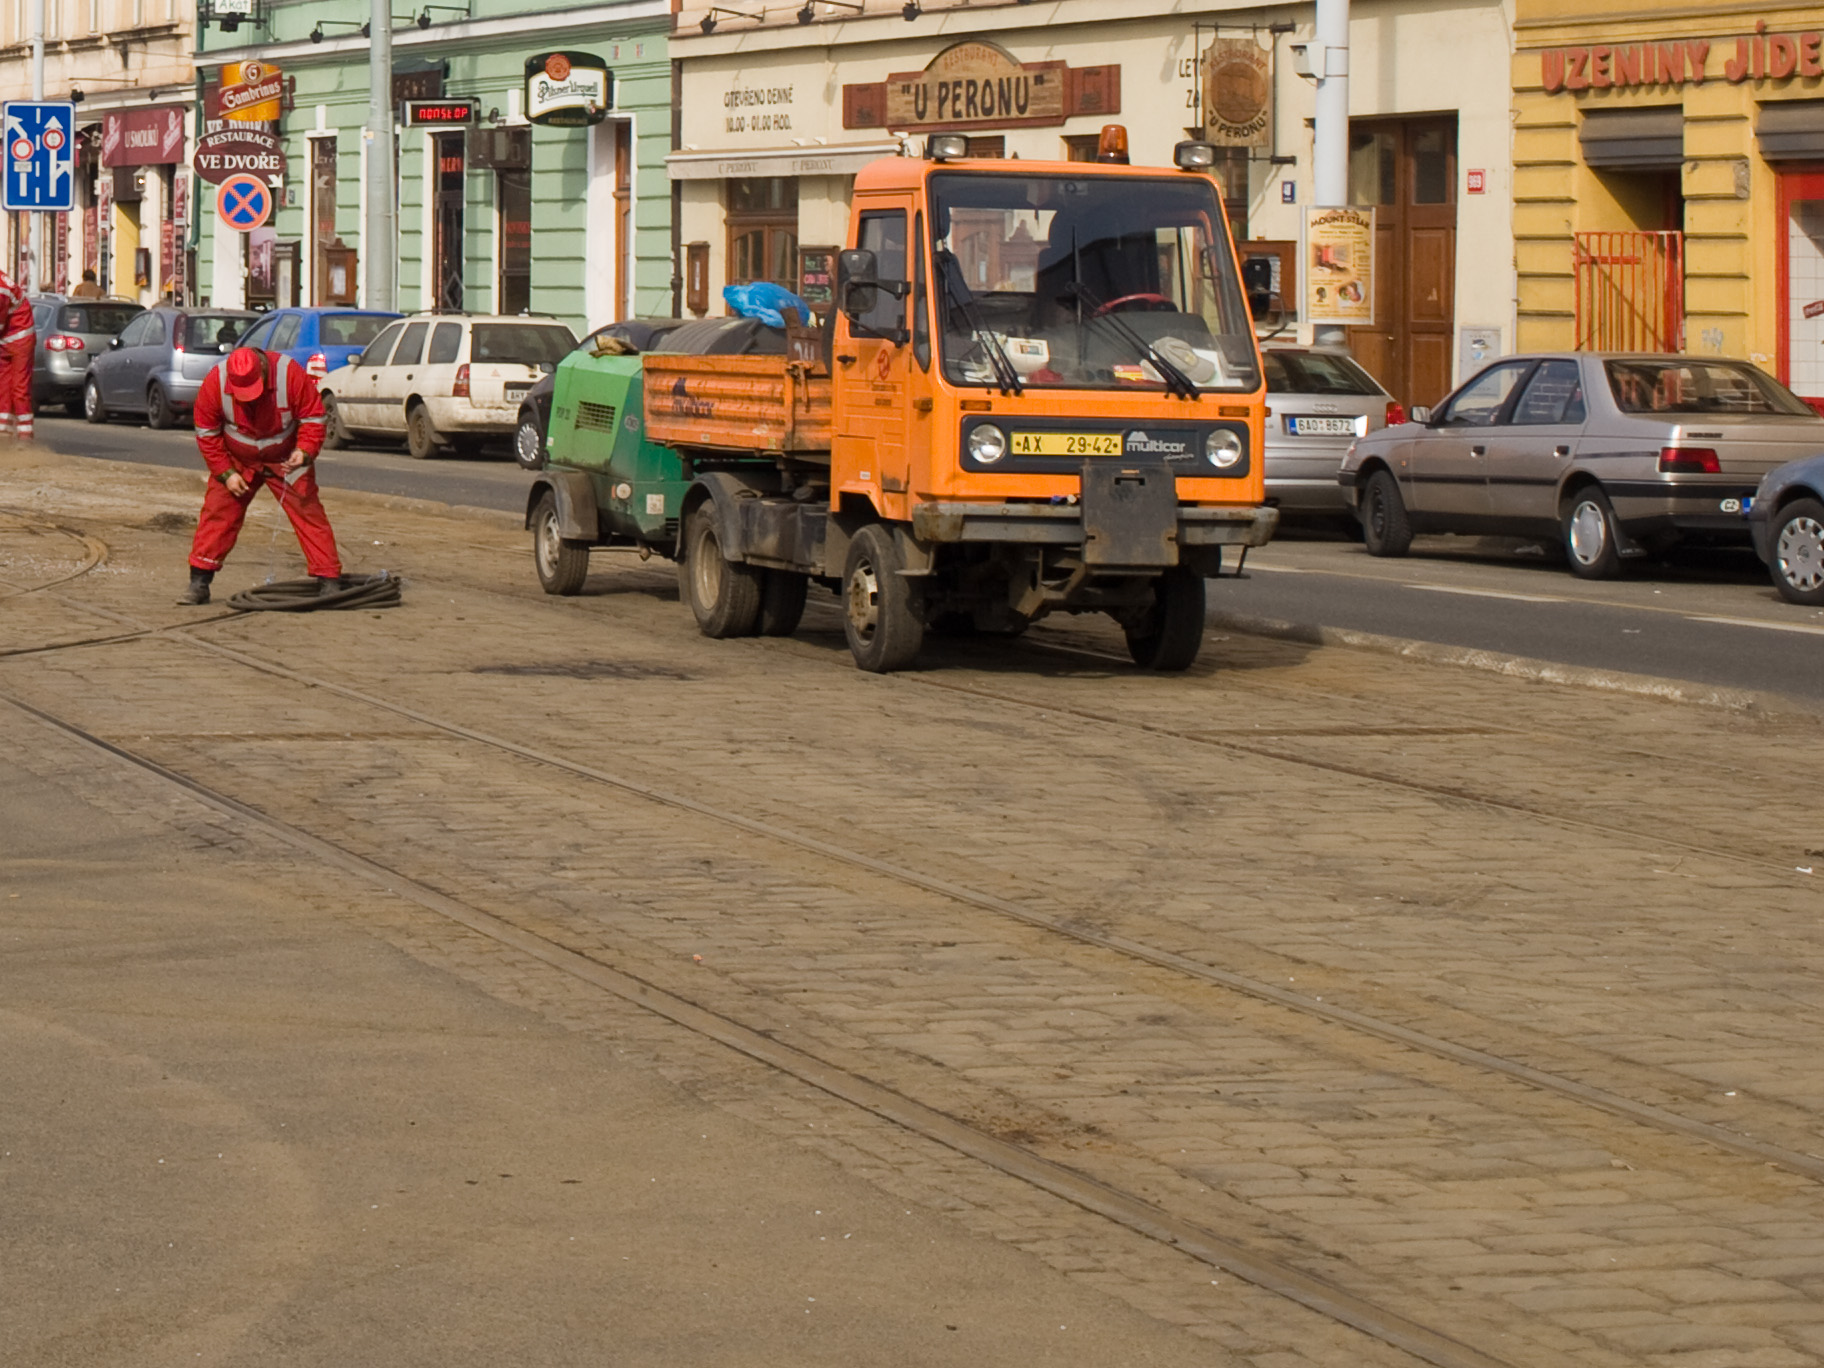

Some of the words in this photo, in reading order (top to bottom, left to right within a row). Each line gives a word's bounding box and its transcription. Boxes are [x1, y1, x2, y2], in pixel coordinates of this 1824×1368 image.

[1541, 40, 1710, 92] UZENINY
[222, 81, 281, 108] Gambrinus
[537, 80, 570, 104] Pilsner
[569, 80, 598, 93] Urquell
[206, 132, 275, 149] RESTAURACE
[199, 154, 221, 169] VE
[224, 151, 281, 169] DVOŘE
[1022, 436, 1042, 452] AX
[1066, 436, 1113, 453] 29-42
[1126, 439, 1186, 453] multicar
